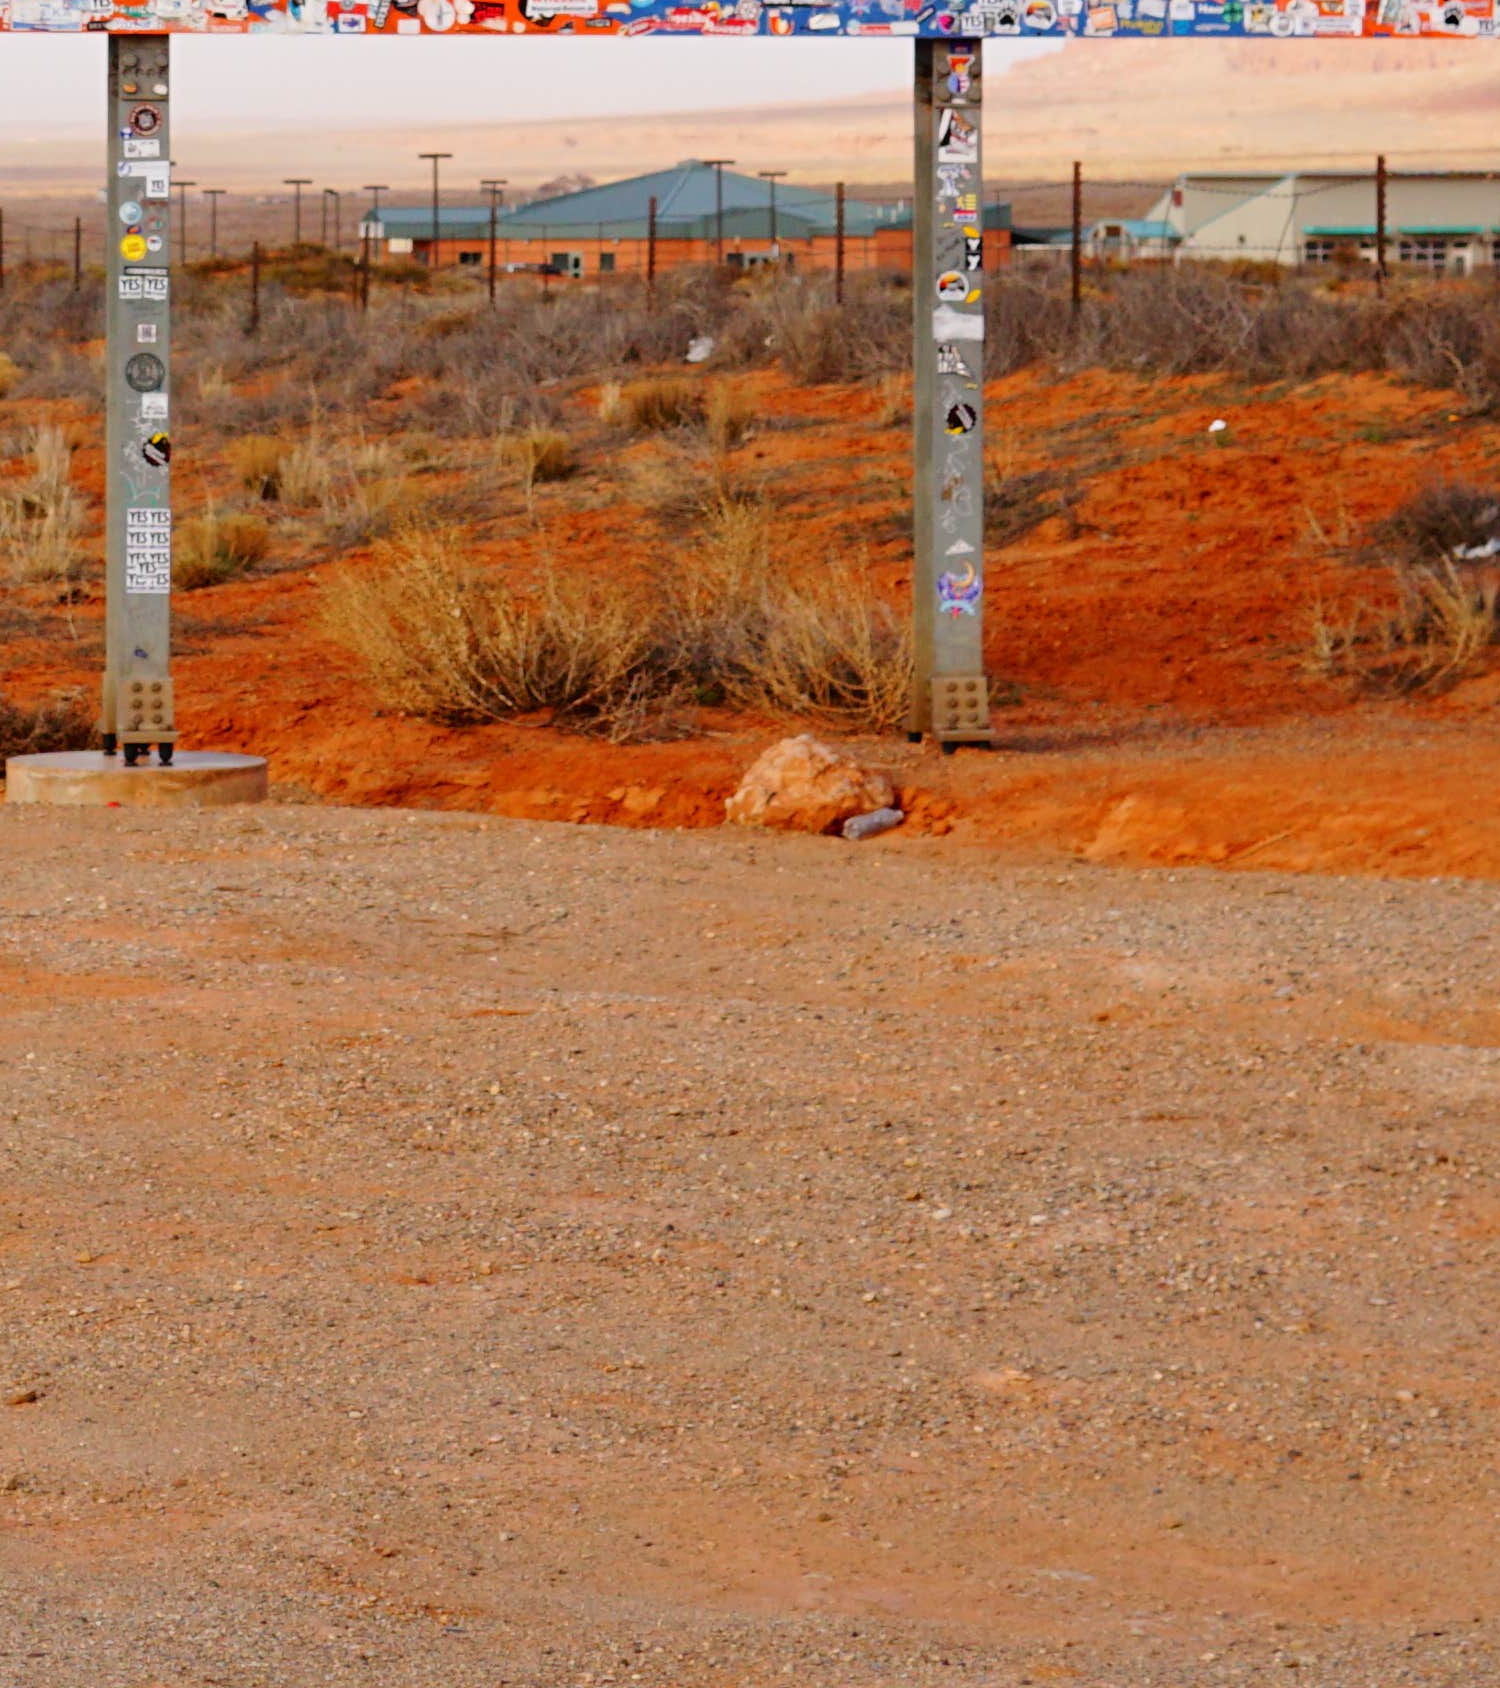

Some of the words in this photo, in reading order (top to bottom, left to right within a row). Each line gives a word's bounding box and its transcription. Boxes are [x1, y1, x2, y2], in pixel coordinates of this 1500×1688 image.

[121, 279, 141, 291] YES
[145, 279, 166, 291] YES
[129, 511, 149, 523] YES
[150, 511, 169, 523] YES
[129, 532, 149, 544] YES
[150, 532, 169, 544] YES
